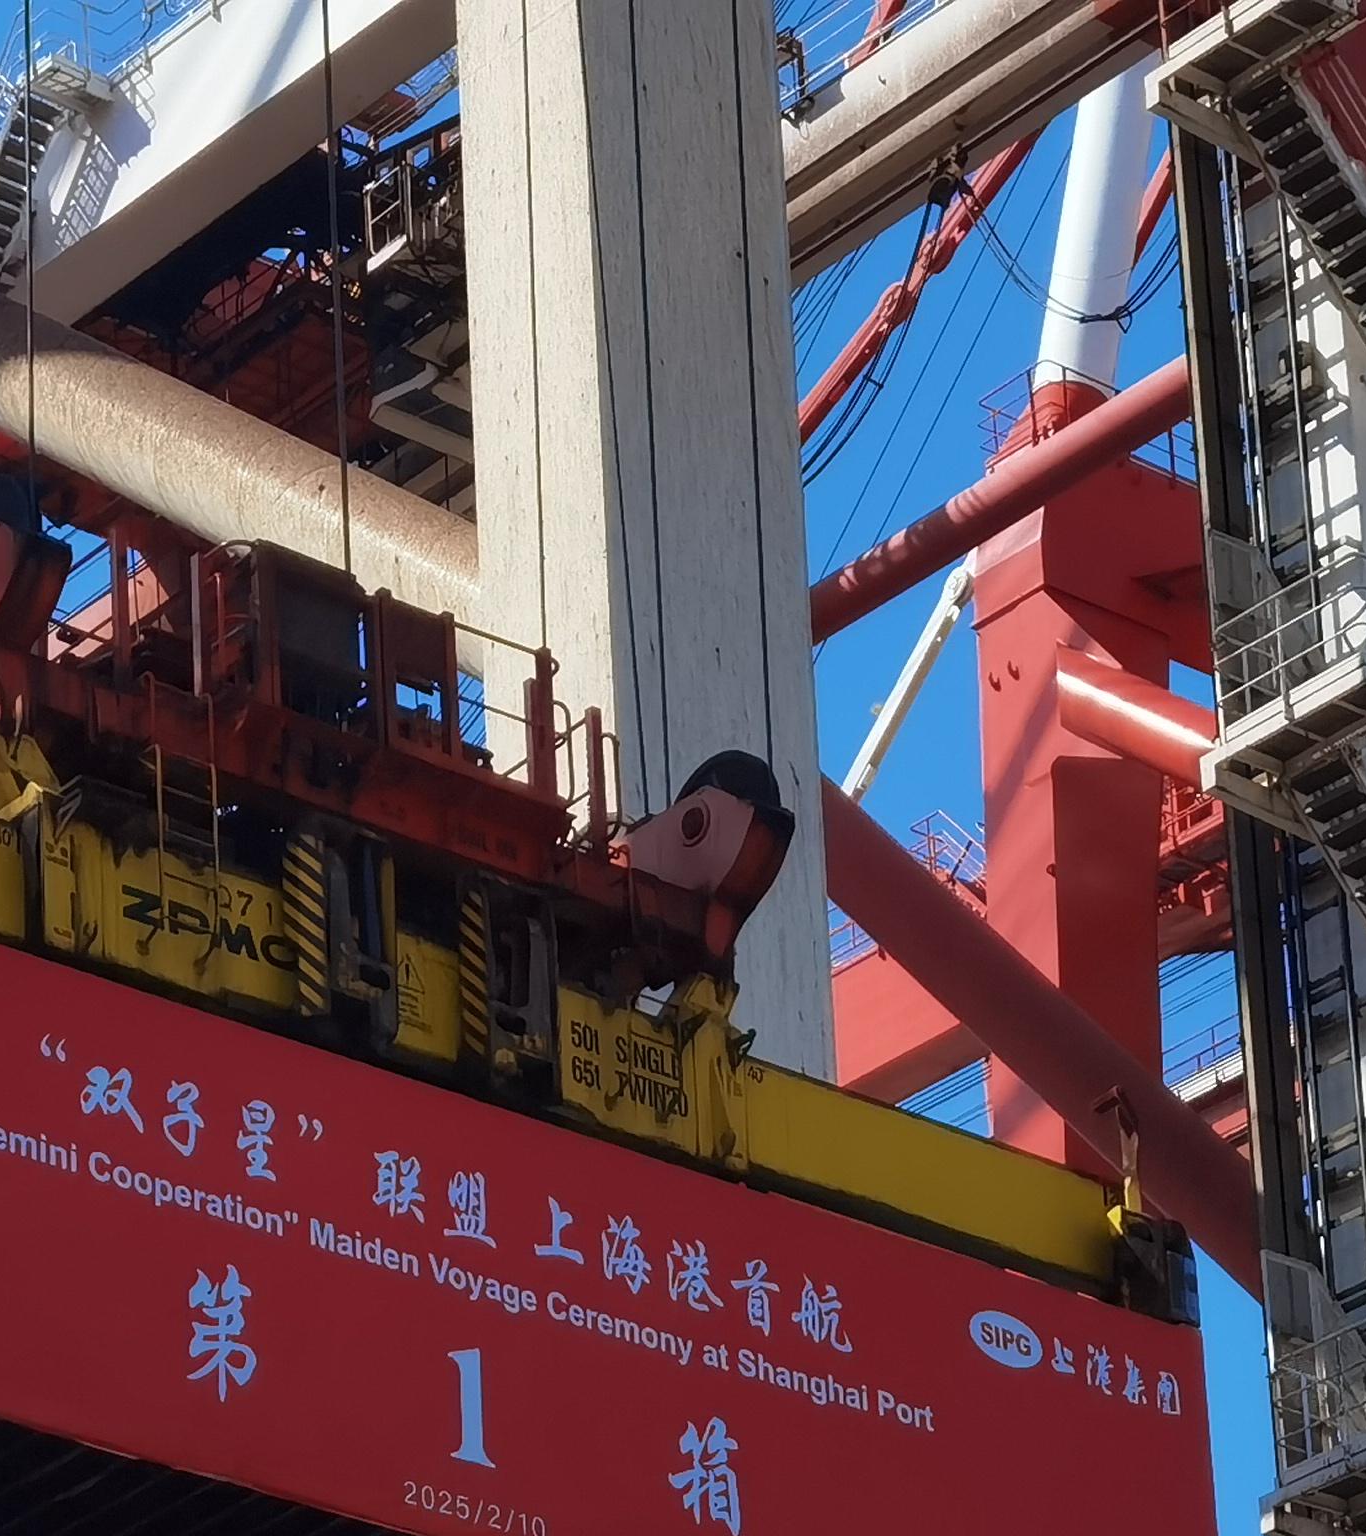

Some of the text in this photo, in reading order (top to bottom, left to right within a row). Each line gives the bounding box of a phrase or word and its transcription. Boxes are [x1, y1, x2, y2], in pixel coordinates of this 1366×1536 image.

[121, 883, 299, 971] ZPMC
[614, 1034, 681, 1083] SNGLE
[88, 1151, 299, 1237] Cooperation"
[310, 1217, 420, 1277] Maiden
[428, 1252, 537, 1314] Voyage
[546, 1291, 693, 1366] Ceremony
[702, 1343, 730, 1372] at
[737, 1348, 869, 1412] Shanghai
[877, 1384, 935, 1432] Port
[186, 1263, 257, 1403] 第
[447, 1347, 496, 1469] 1
[979, 1321, 1033, 1358] SIPG
